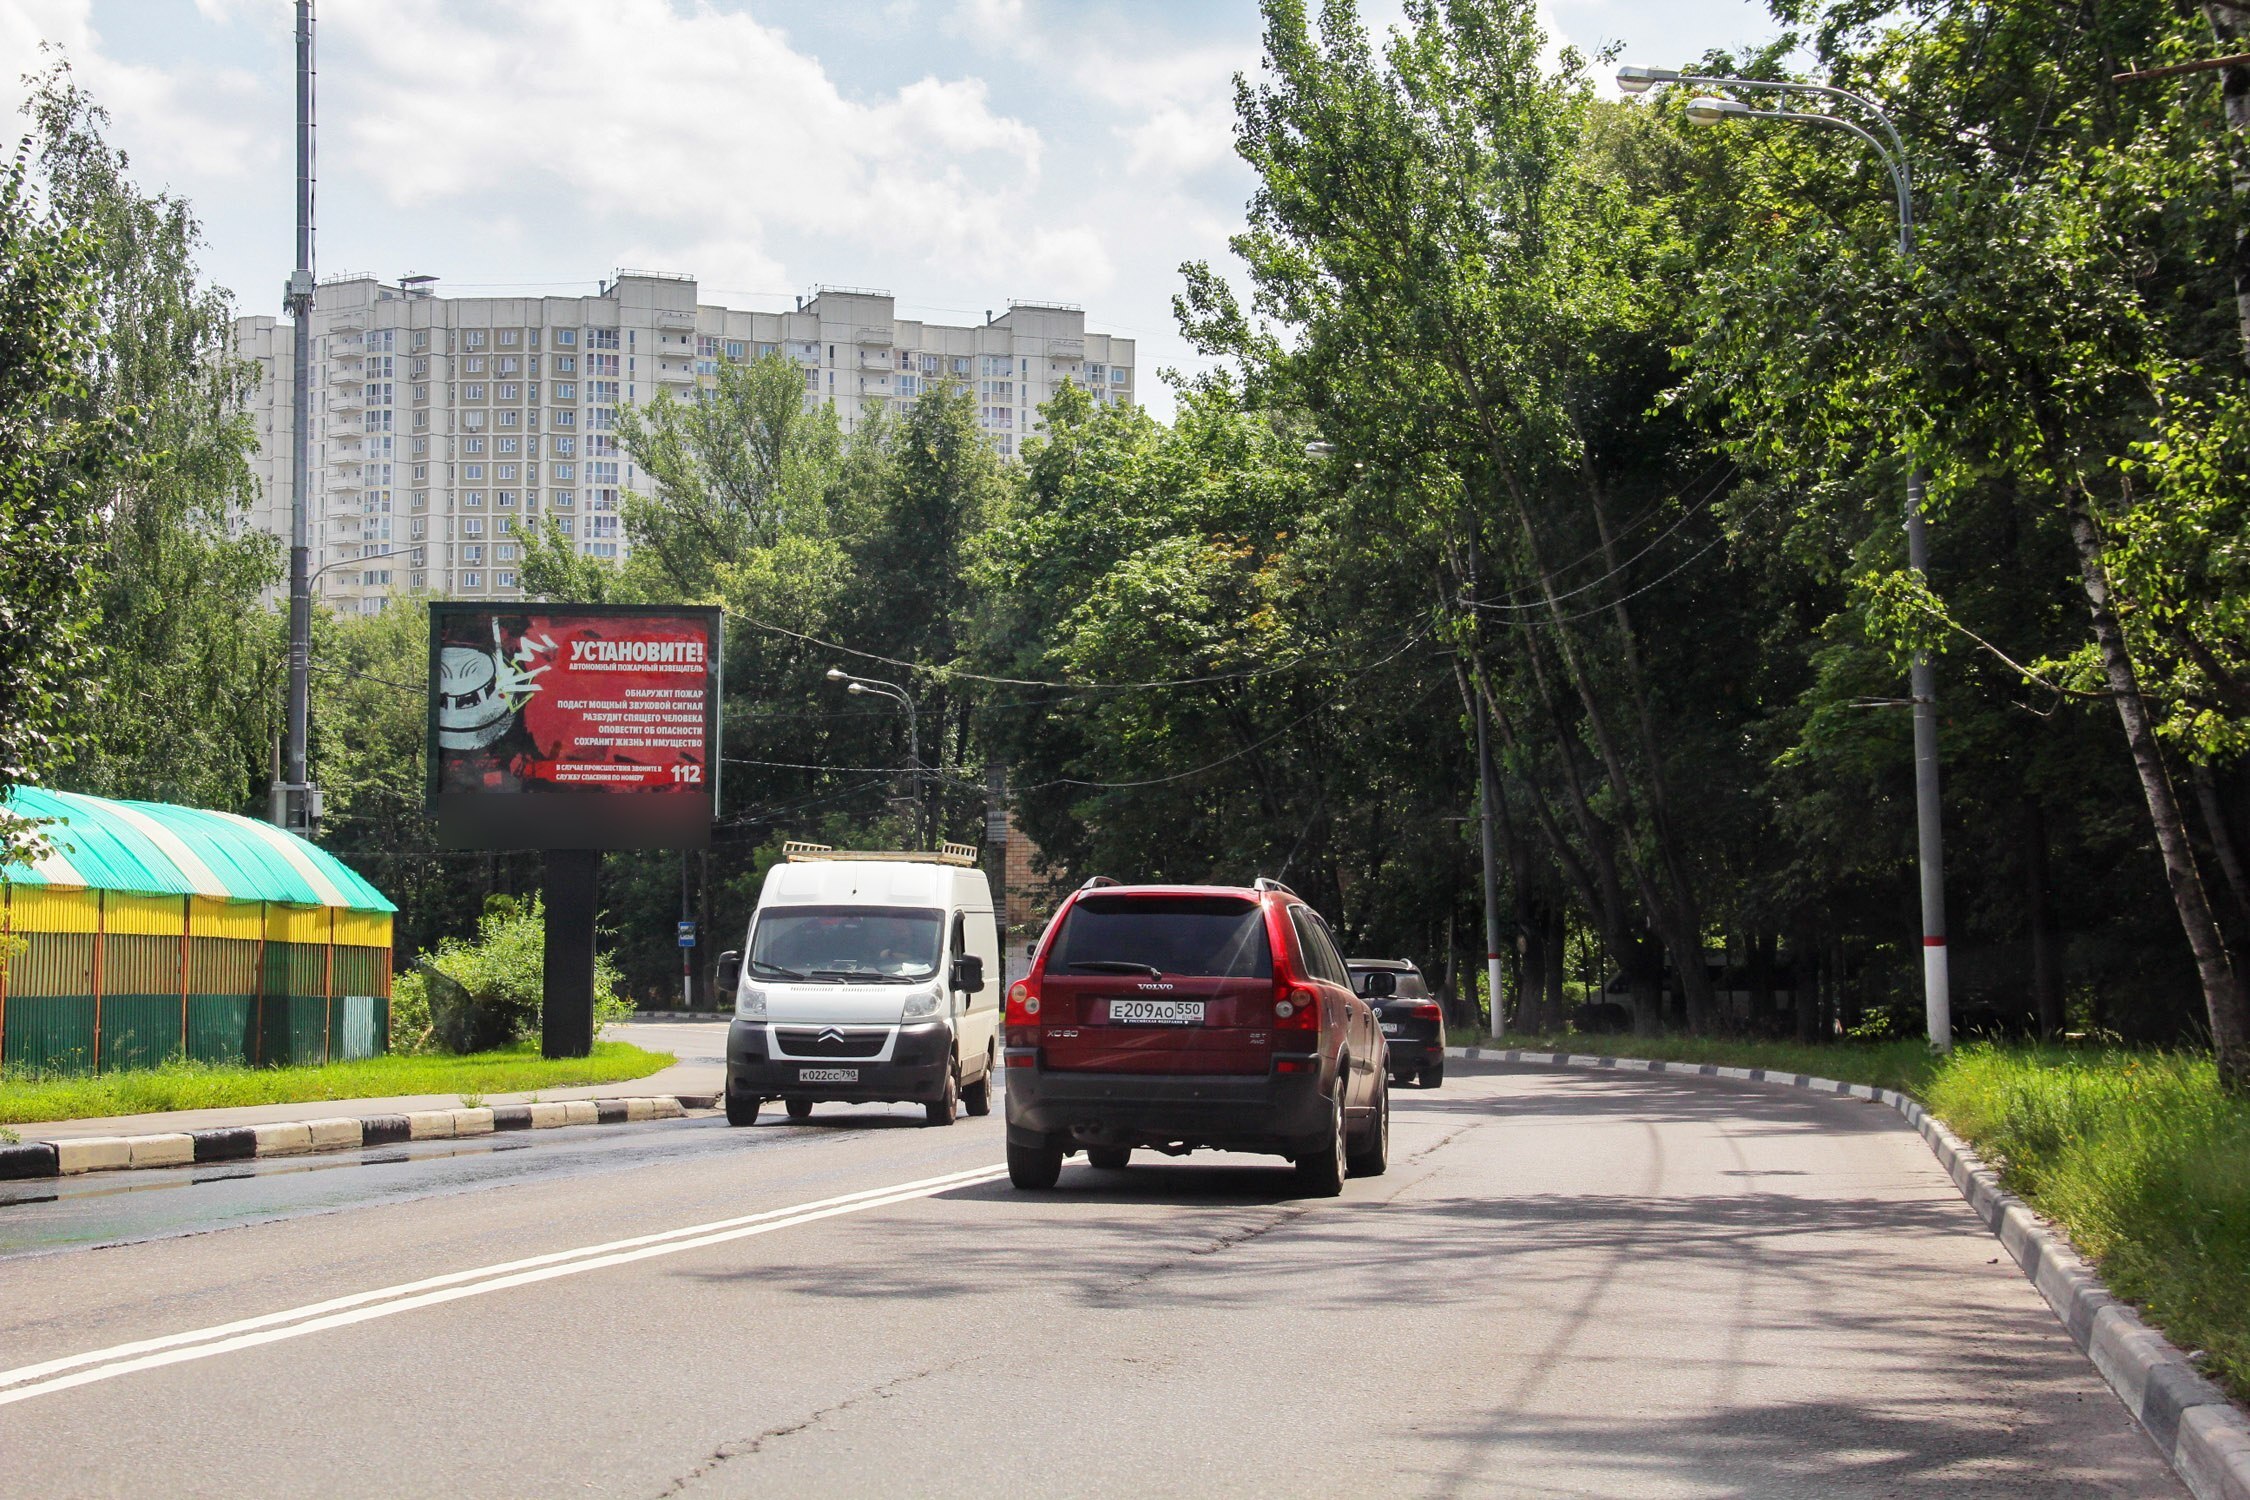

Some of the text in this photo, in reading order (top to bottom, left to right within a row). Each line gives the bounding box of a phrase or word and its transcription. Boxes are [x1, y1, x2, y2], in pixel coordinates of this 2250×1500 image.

[570, 641, 704, 662] УСТАНОВИТЕ!
[569, 662, 704, 673] АВТОНОМНЫЙ ПОЖАРНЫЙ ИЗВЕЩАТЕЛЬ
[625, 689, 704, 699] ОБНАРУЖИТ ПОЖАР
[557, 700, 703, 711] ПОДАСТ МОЩНЫЙ ЗВУКОВОЙ СИГНАЛ
[582, 713, 703, 723] РАЗБУДИТ СПЯЩЕГО ЧЕЛОВЕКА
[598, 725, 703, 736] ОПОВЕСТИТ ОБ ОПАСНОСТИ
[574, 737, 703, 748] СОХРАНИТ ЖИЗНЬ И ИМУЩЕСТВО
[561, 764, 584, 772] СЛУЧАЕ
[584, 765, 631, 773] ПРОИСШЕСТВИЯ
[671, 765, 701, 783] 112
[581, 774, 612, 782] СПАСЕНИЯ
[612, 774, 620, 782] ПО
[621, 774, 644, 782] НОМЕРУ
